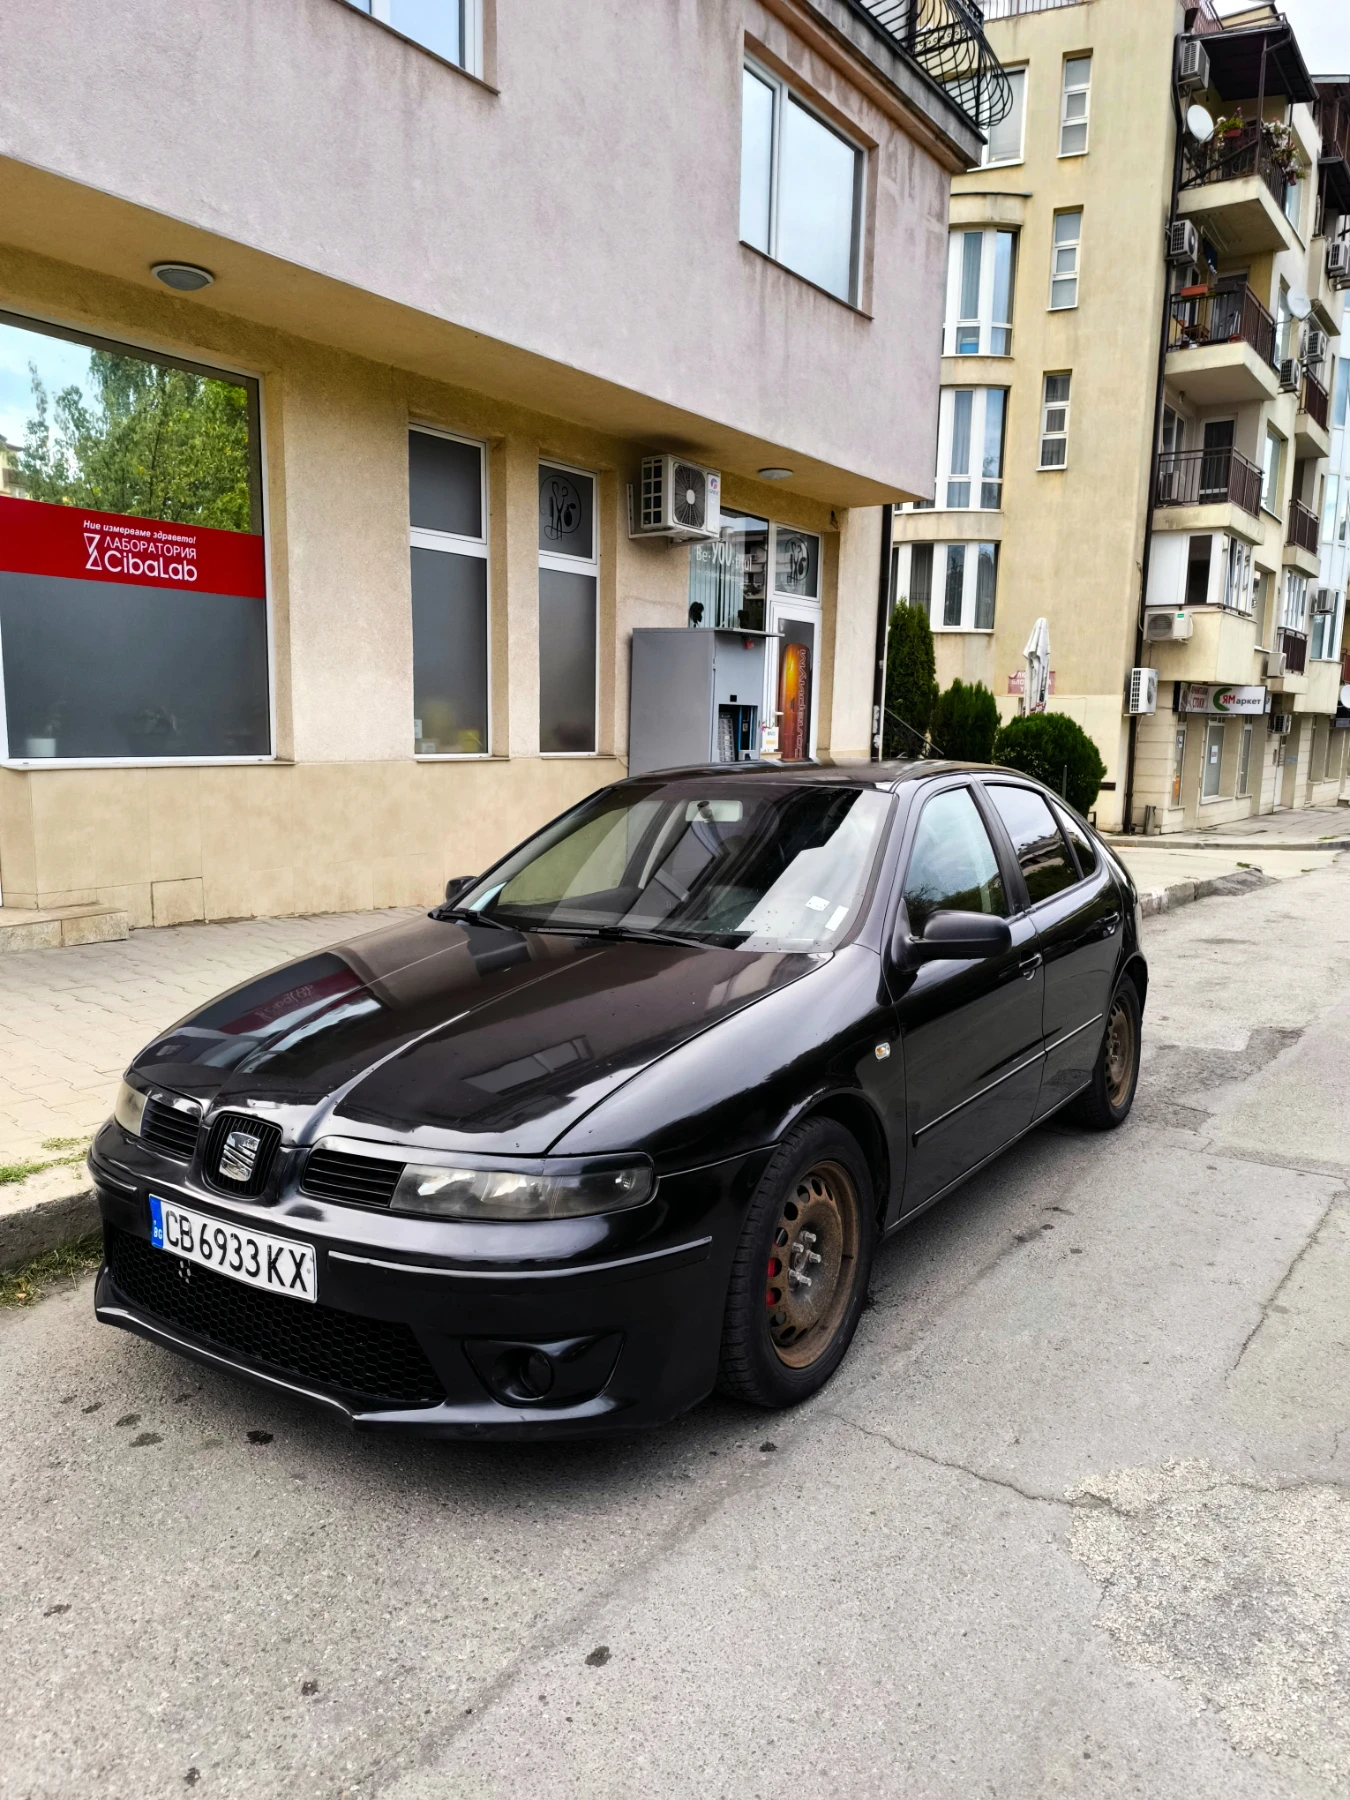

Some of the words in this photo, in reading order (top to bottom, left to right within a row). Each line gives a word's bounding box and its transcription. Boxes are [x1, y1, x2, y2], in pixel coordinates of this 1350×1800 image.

[83, 519, 101, 530] Ние
[103, 524, 151, 538] измерваме
[153, 530, 197, 544] здравето!
[104, 536, 197, 560] ЛАБОРАТОРИЯ
[104, 550, 198, 582] CibaLab
[1222, 694, 1262, 707] ЯМаркет
[165, 1210, 194, 1253] CB
[199, 1223, 261, 1278] 6933
[267, 1244, 308, 1293] KX
